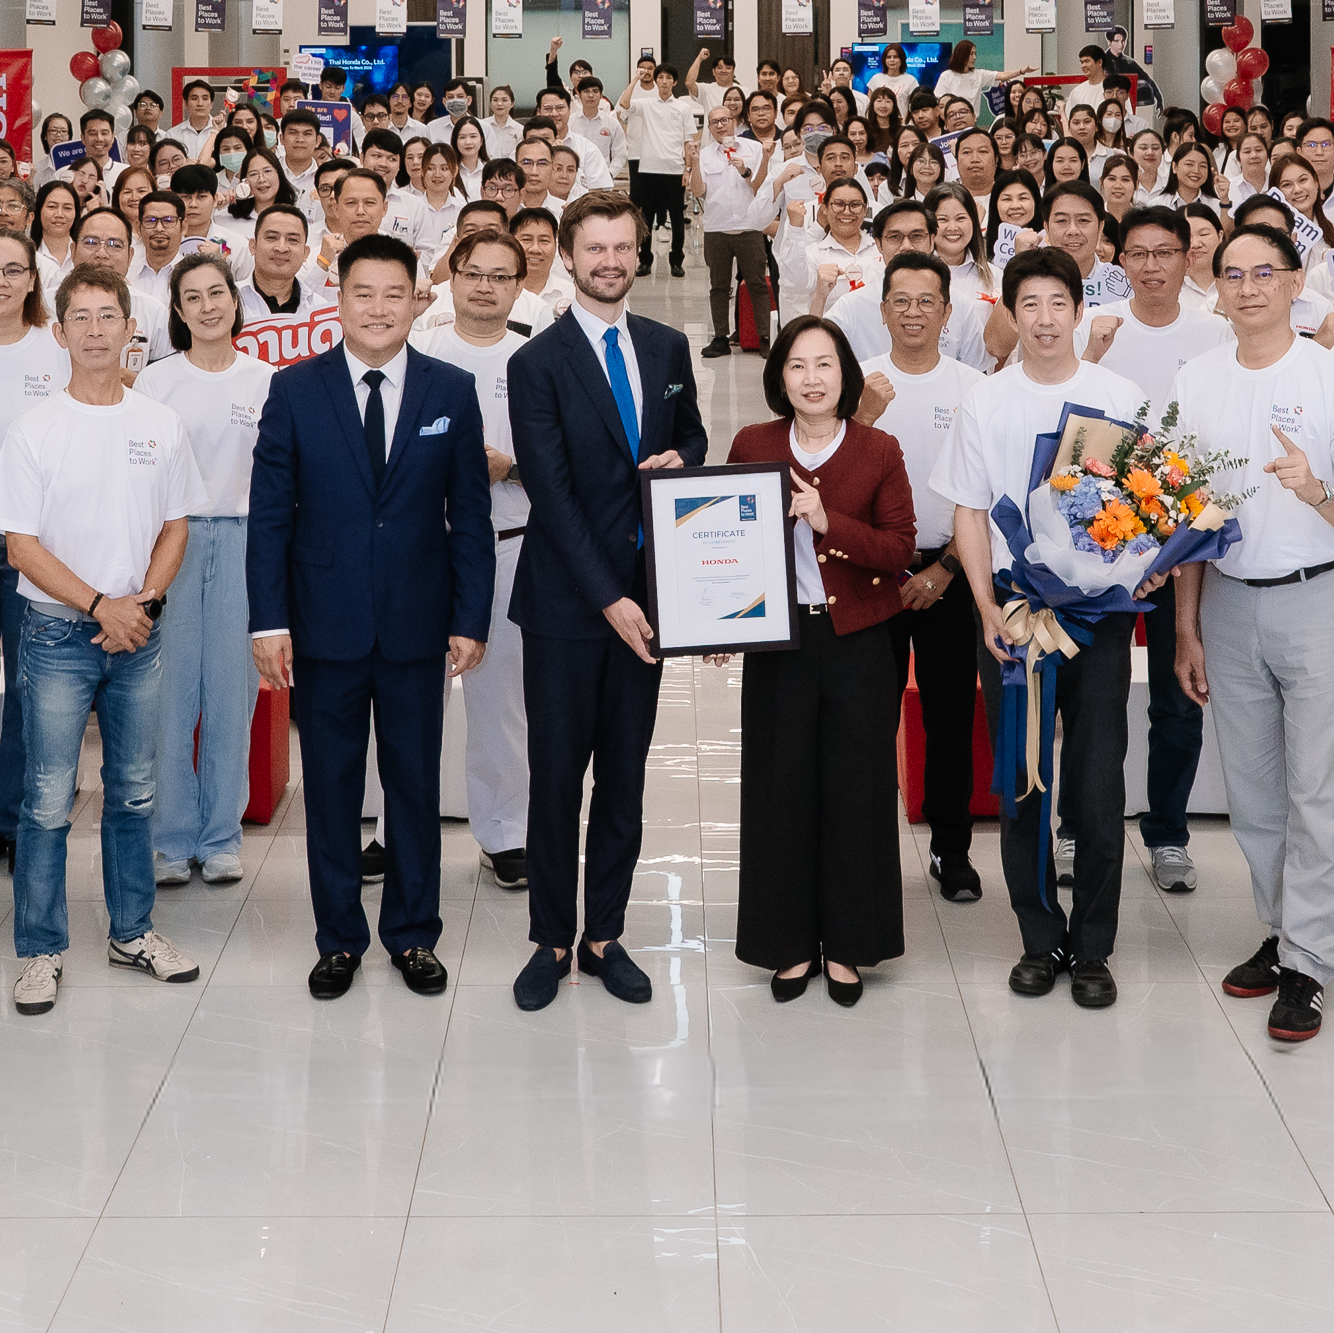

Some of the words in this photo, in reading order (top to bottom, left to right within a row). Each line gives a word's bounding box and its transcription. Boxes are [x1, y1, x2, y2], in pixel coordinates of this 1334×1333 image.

[58, 150, 70, 158] We
[1295, 324, 1316, 332] HONDA
[693, 530, 745, 539] CERTIFICATE
